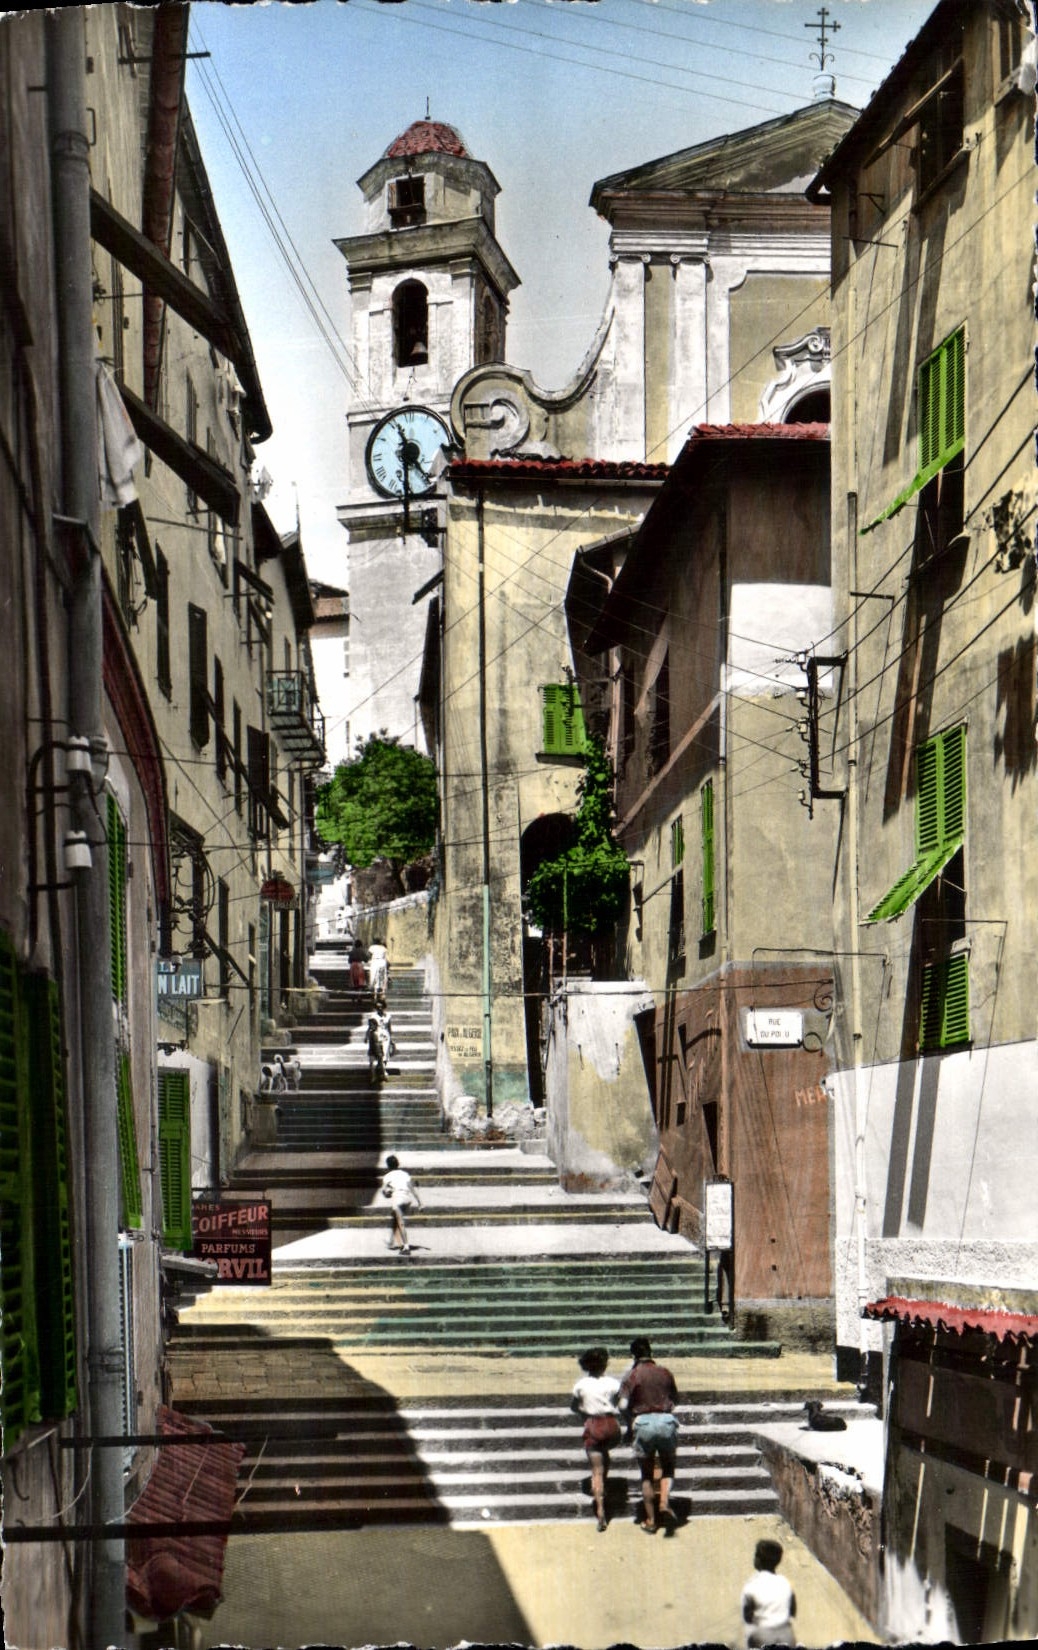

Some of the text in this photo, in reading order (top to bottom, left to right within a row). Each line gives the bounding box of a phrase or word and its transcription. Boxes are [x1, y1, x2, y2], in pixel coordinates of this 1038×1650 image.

[171, 974, 200, 995] LAIT
[768, 1018, 782, 1026] RUE
[191, 1205, 269, 1235] COIFFEUR
[201, 1243, 256, 1254] PARFUMS
